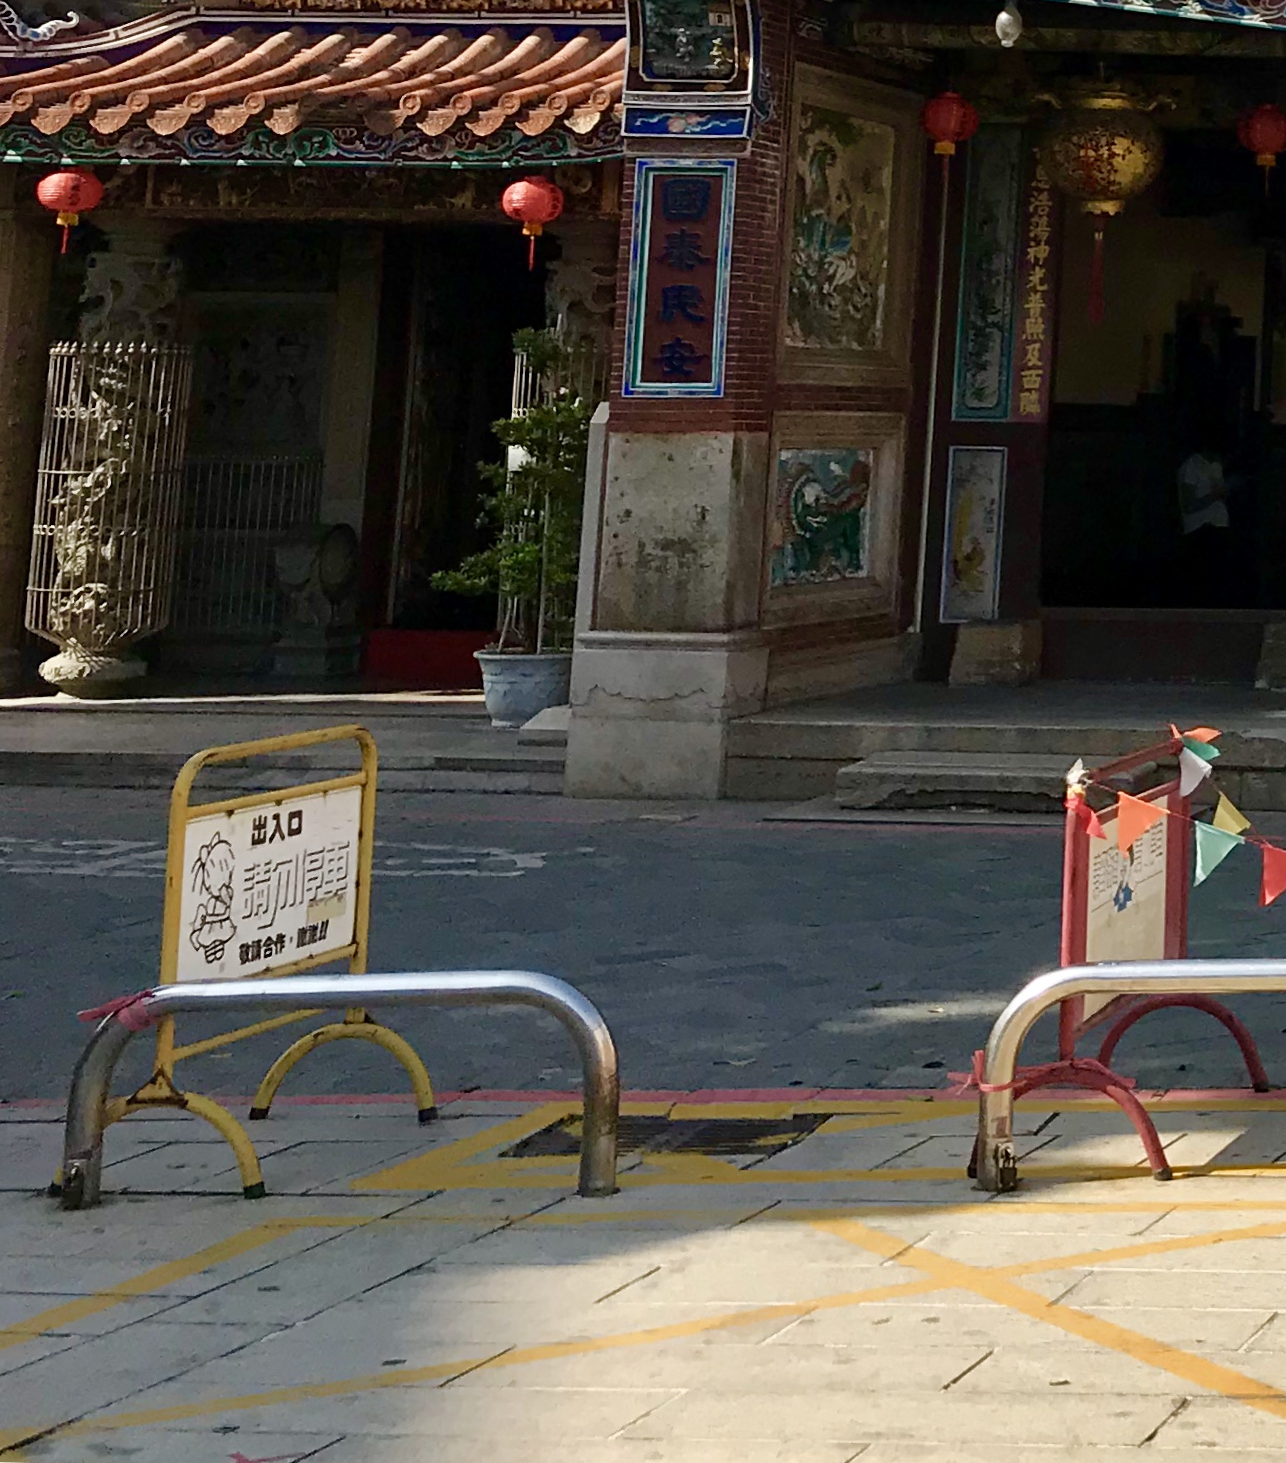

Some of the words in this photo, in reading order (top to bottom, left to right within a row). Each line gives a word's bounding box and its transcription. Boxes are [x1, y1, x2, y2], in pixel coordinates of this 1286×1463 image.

[653, 177, 712, 375] 國泰民安
[251, 809, 303, 846] 出入口
[242, 840, 350, 930] 請勿停車
